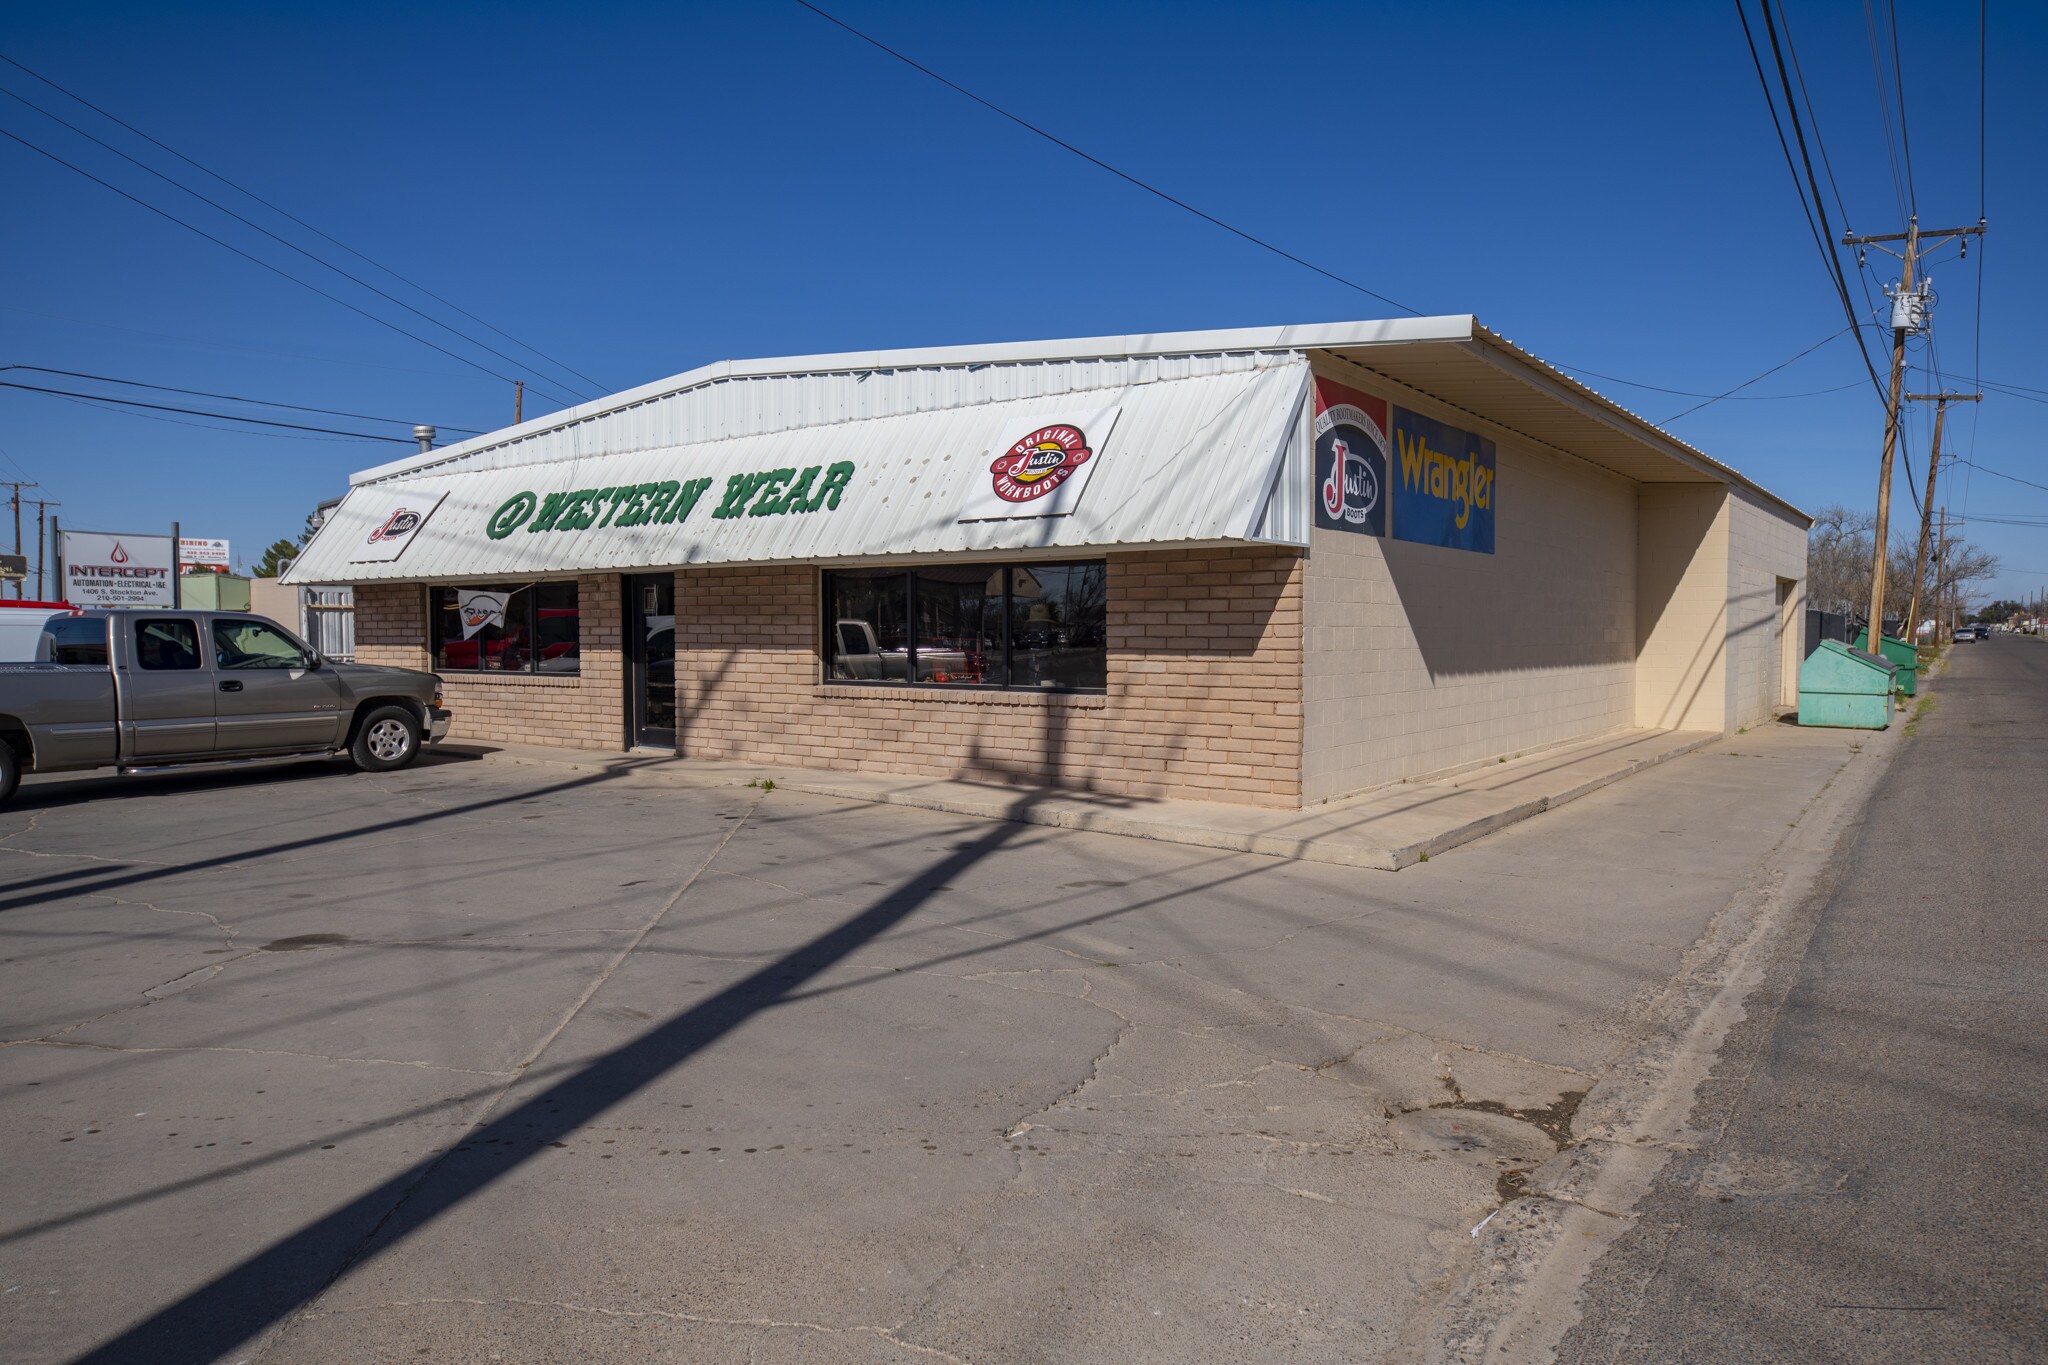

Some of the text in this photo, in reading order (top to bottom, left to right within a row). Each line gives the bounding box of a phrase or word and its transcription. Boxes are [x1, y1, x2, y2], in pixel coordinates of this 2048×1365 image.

[1315, 411, 1336, 434] QUALITY
[1335, 407, 1366, 426] BOOTMAKERS
[1015, 429, 1078, 452] ORIGINAL
[1010, 448, 1060, 475] Justin
[996, 468, 1069, 499] WORKBOOTS
[1325, 443, 1373, 514] Justin
[1397, 427, 1494, 529] Wrangler
[527, 477, 713, 533] WESTERN
[711, 460, 856, 519] WEAR
[369, 509, 415, 542] Justin
[1346, 507, 1364, 519] BOOTS
[69, 564, 169, 579] INTERCEPT
[73, 579, 114, 588] AUTOMATION
[117, 580, 152, 588] ELECTRICAL
[109, 588, 141, 596] Stockton
